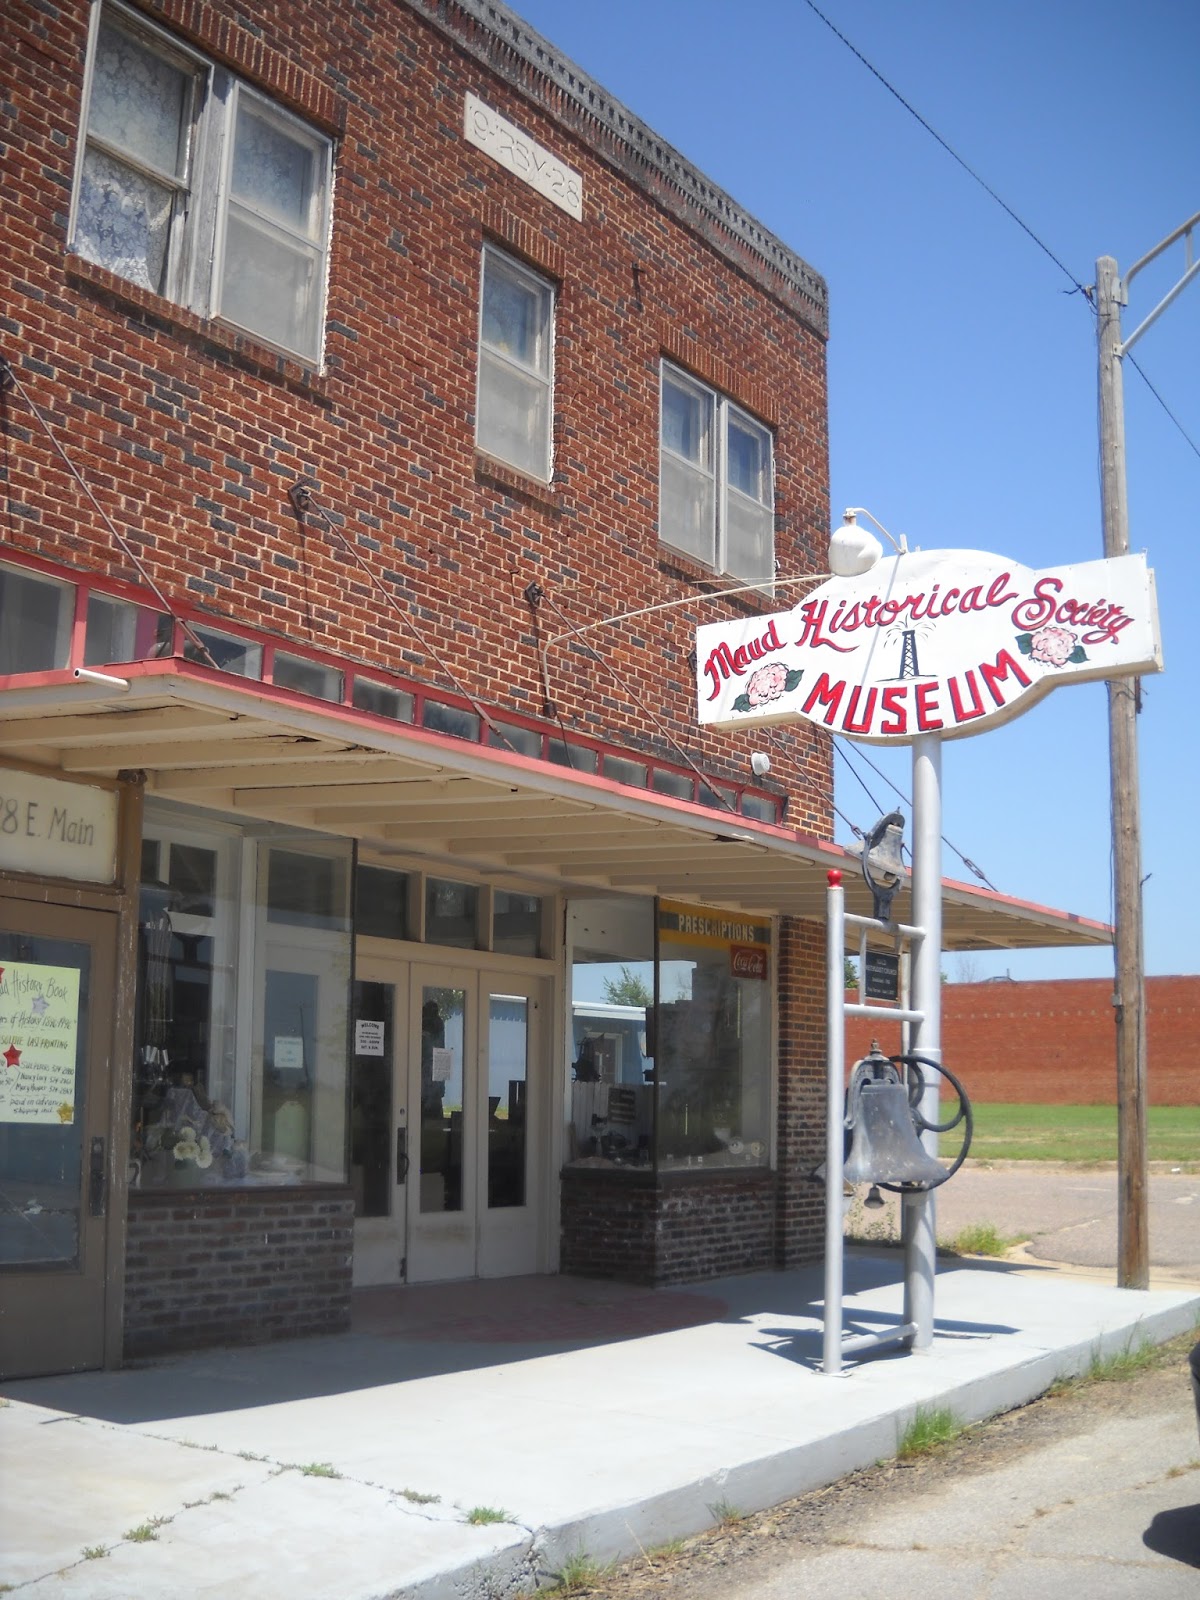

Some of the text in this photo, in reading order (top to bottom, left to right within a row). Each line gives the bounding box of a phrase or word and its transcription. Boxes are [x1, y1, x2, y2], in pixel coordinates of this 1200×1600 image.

[703, 571, 1136, 701] Maud Historical Society
[799, 648, 1033, 735] MUSEUM
[0, 797, 19, 834] 8
[47, 807, 94, 846] Main
[11, 969, 42, 1004] History
[46, 977, 67, 1003] Book
